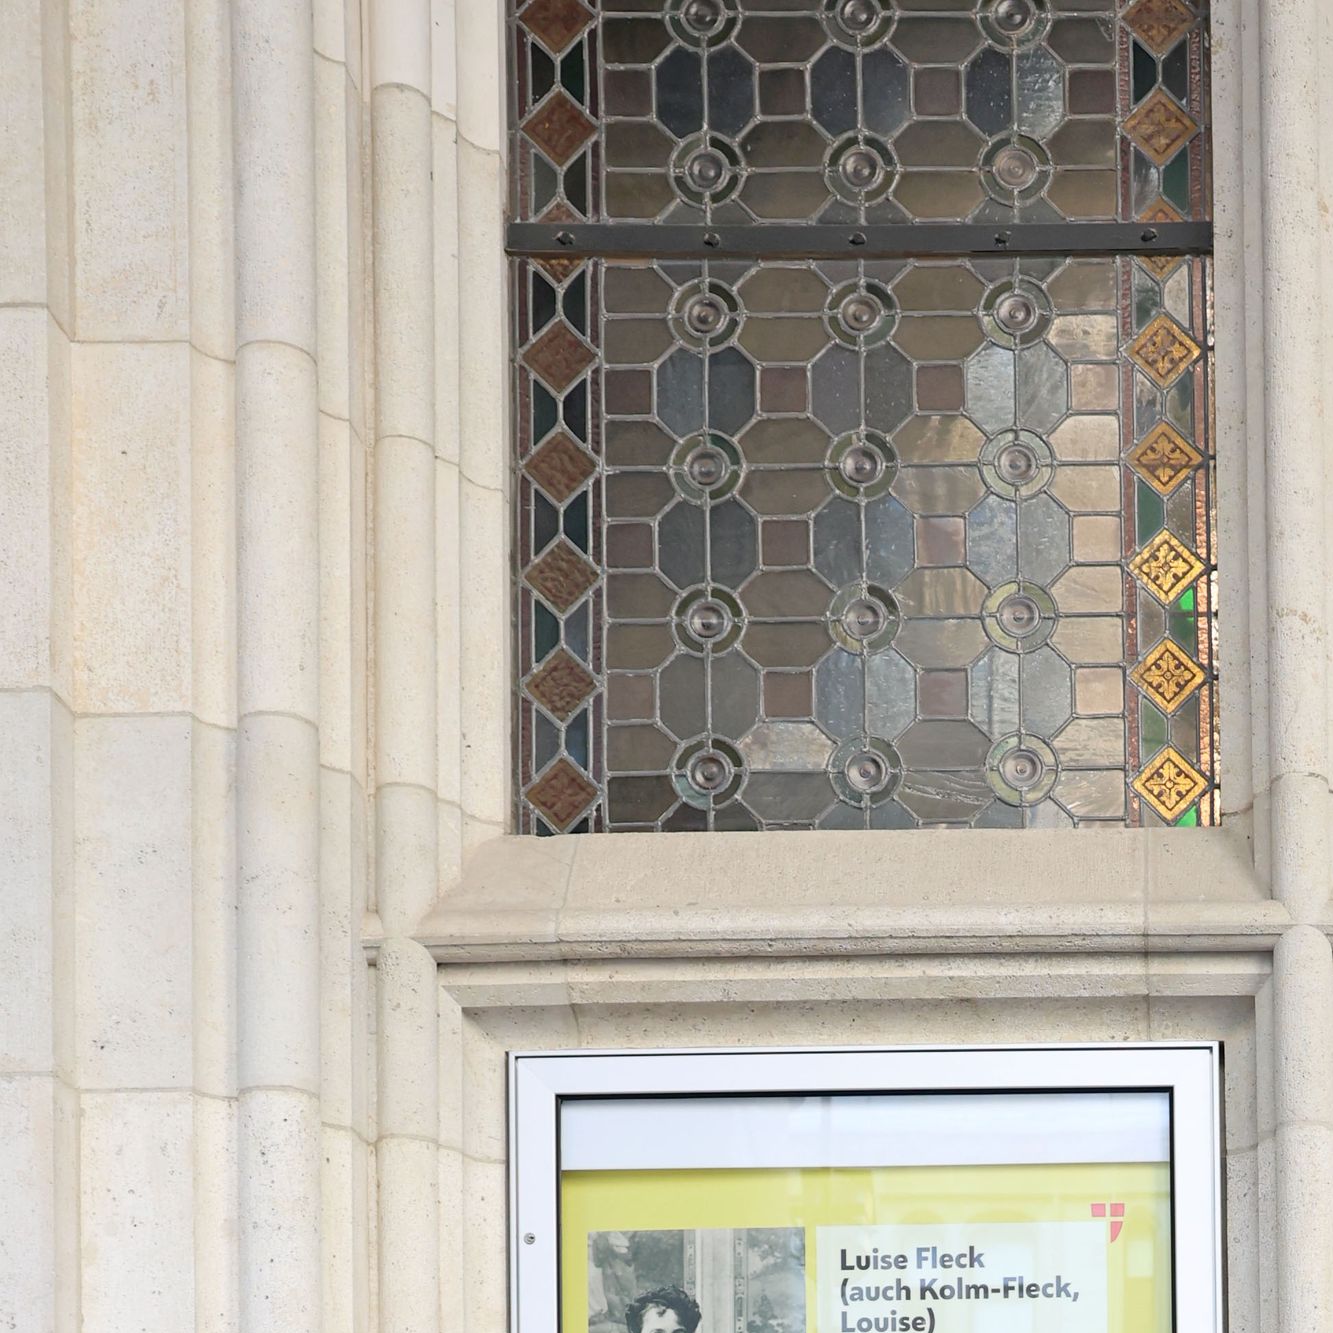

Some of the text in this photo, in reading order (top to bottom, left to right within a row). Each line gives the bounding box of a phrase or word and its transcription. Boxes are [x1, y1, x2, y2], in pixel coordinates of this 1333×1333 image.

[841, 1246, 984, 1270] Luise Fleck
[841, 1276, 1079, 1306] (auch Kolm-Fleck,
